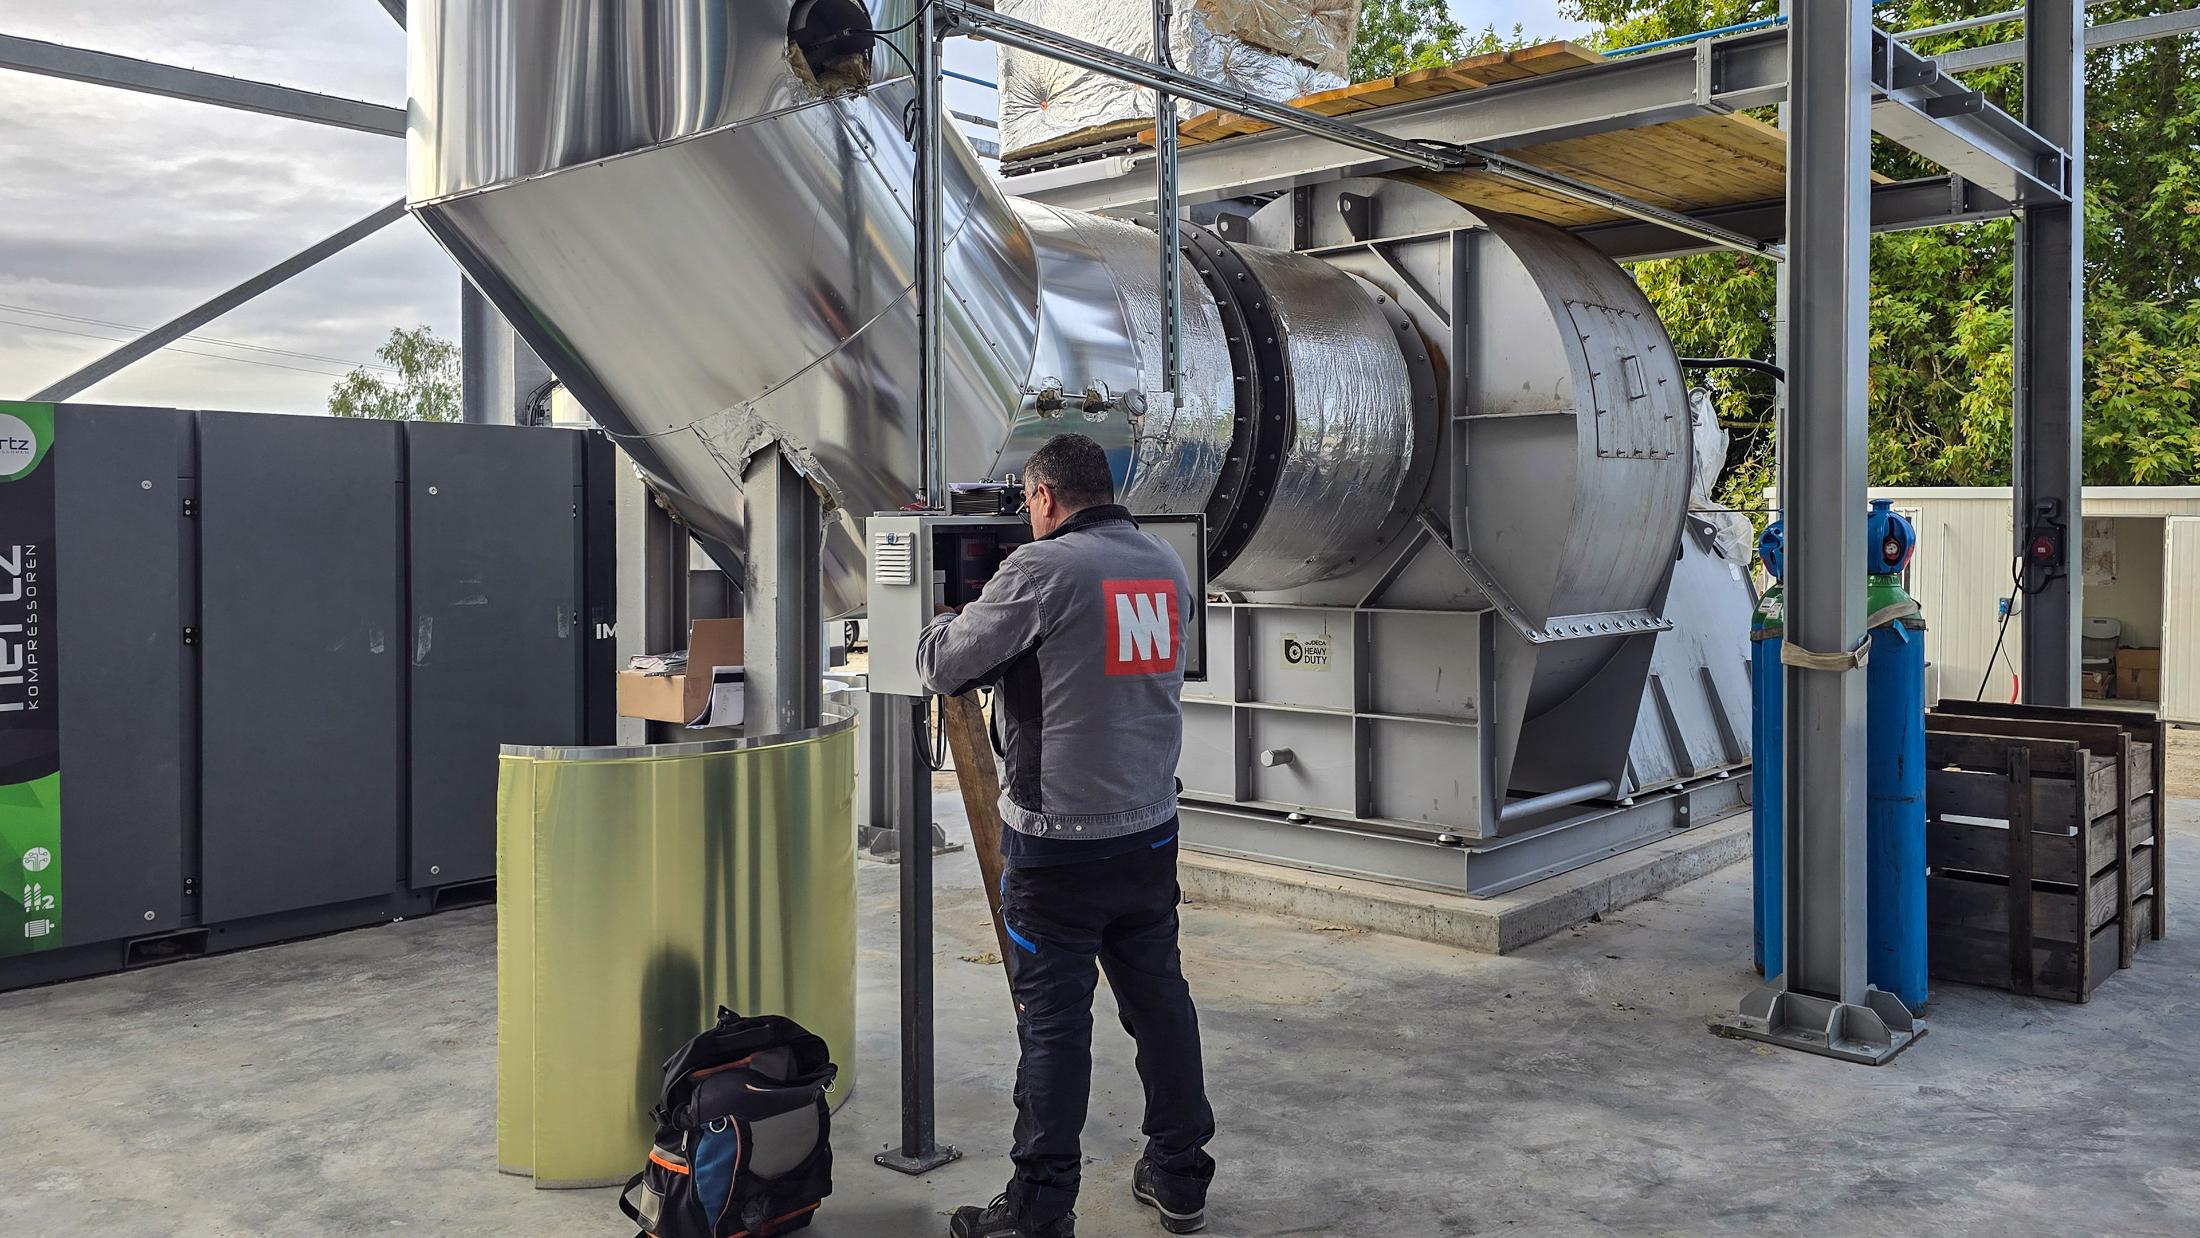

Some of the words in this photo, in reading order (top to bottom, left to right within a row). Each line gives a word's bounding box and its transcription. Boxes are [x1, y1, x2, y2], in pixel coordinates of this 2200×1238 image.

[26, 545, 39, 709] KOMPRESSOREN
[1304, 647, 1327, 655] HEAVY
[1304, 656, 1327, 664] DUTY
